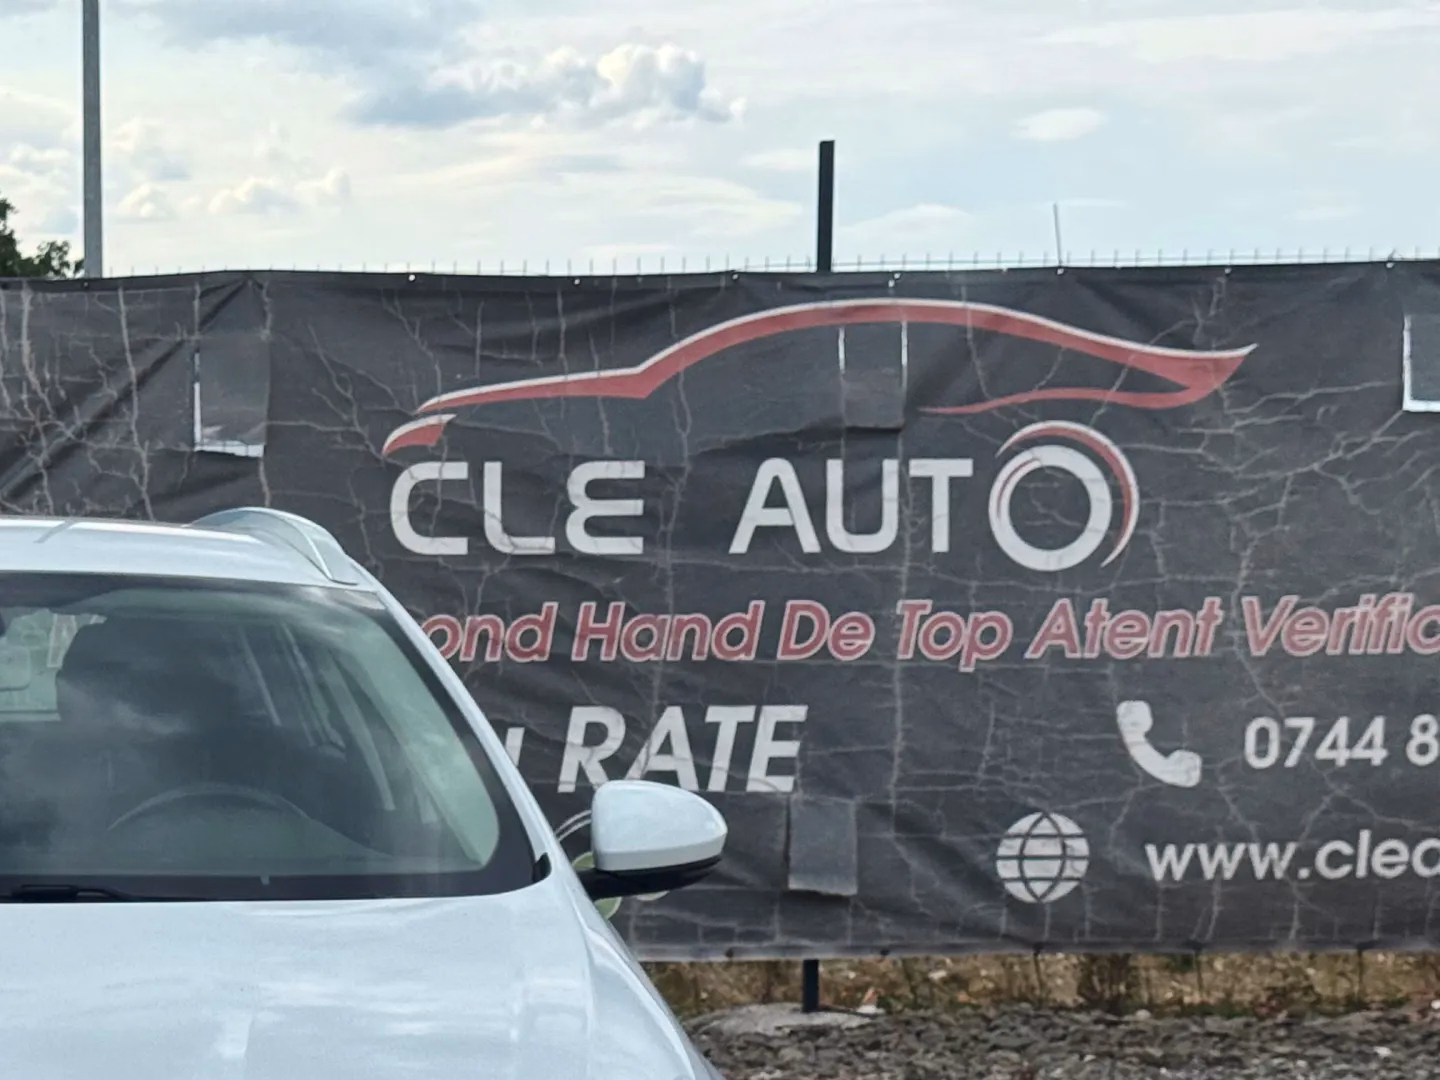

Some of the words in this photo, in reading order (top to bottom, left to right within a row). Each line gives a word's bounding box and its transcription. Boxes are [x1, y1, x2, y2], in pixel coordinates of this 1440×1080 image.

[389, 460, 646, 557] CLE
[727, 443, 1115, 572] AUTO
[570, 599, 765, 663] Hand
[776, 601, 875, 663] De
[895, 601, 1014, 673] Top
[1022, 596, 1224, 661] Atent
[557, 704, 809, 795] RATE
[1244, 715, 1389, 770] 0744
